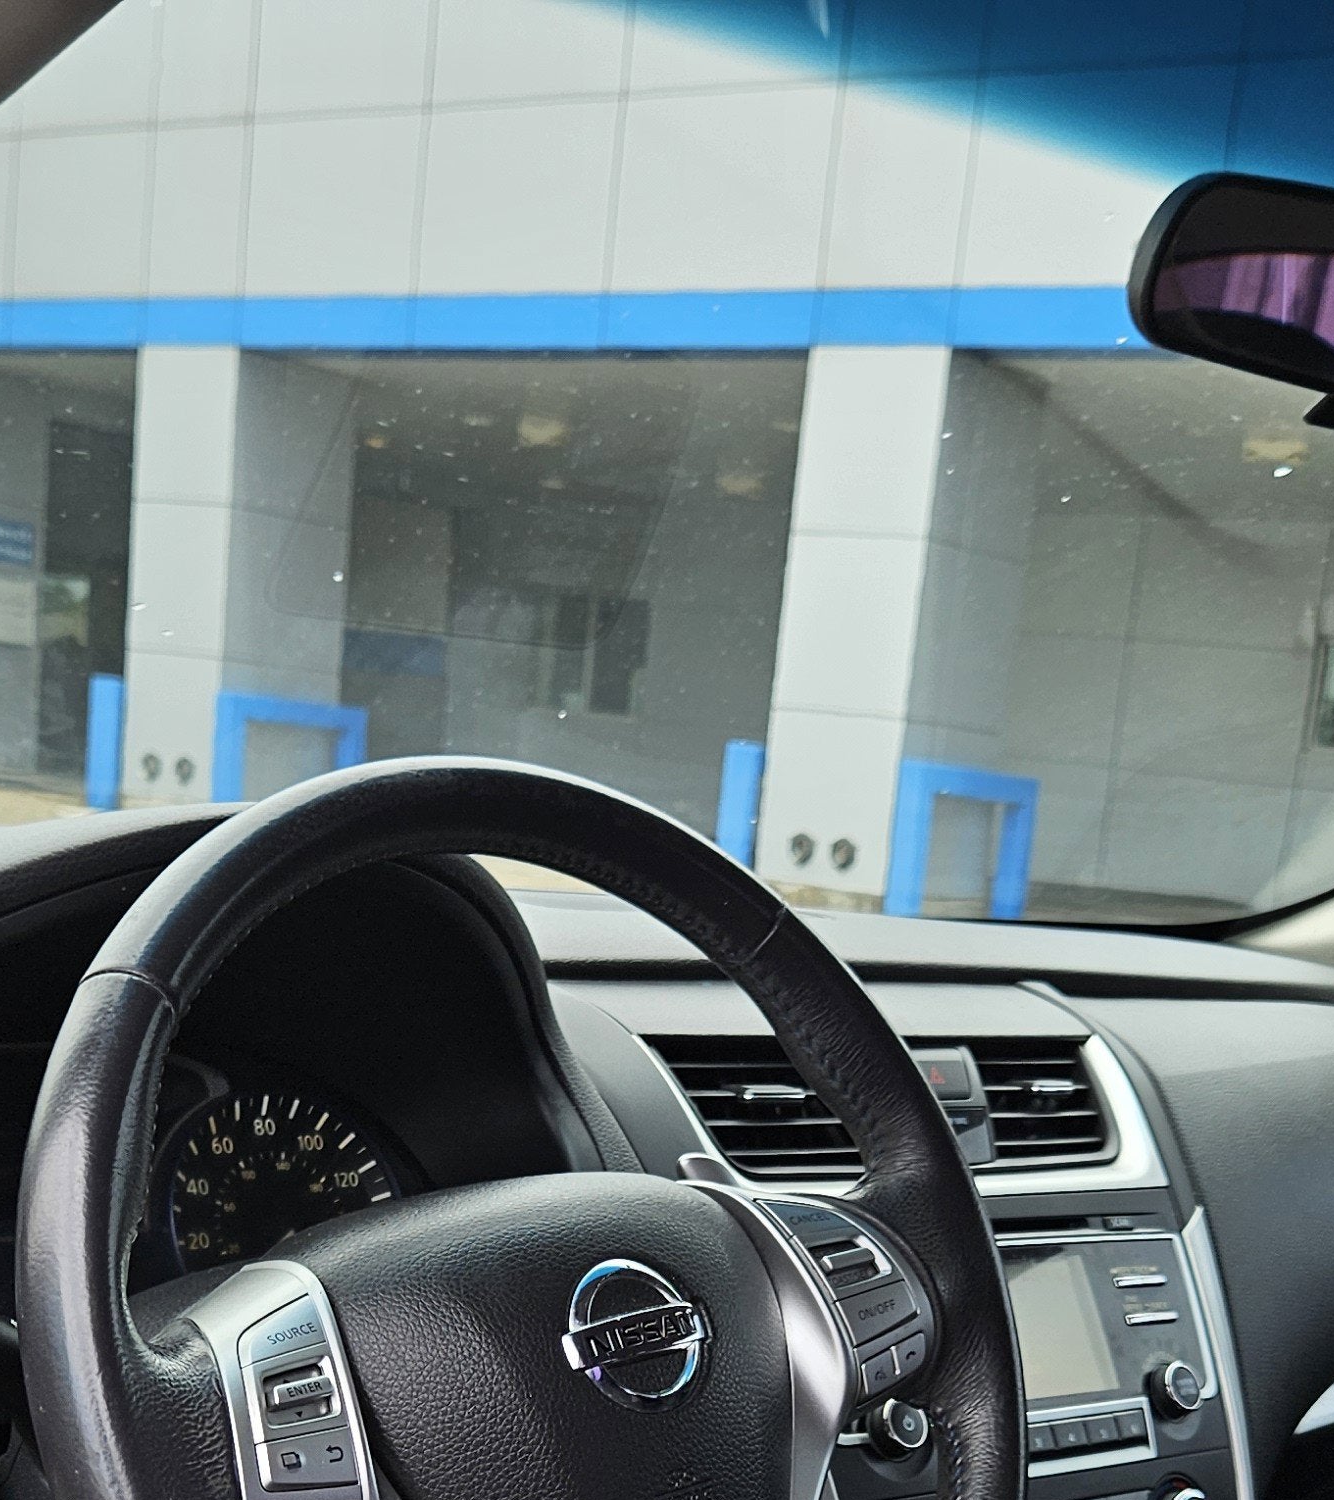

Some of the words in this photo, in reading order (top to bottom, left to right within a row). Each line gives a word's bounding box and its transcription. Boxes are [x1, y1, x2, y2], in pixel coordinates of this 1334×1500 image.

[253, 1118, 276, 1136] 80
[211, 1137, 234, 1154] 60
[297, 1134, 324, 1151] 100
[186, 1178, 209, 1196] 40
[334, 1171, 359, 1188] 120
[788, 1211, 831, 1226] CANCEL
[187, 1232, 210, 1250] 20
[858, 1299, 896, 1321] ON/OFF
[266, 1321, 318, 1346] SOURCE
[585, 1307, 700, 1358] NISSAN
[286, 1380, 323, 1398] ENTER
